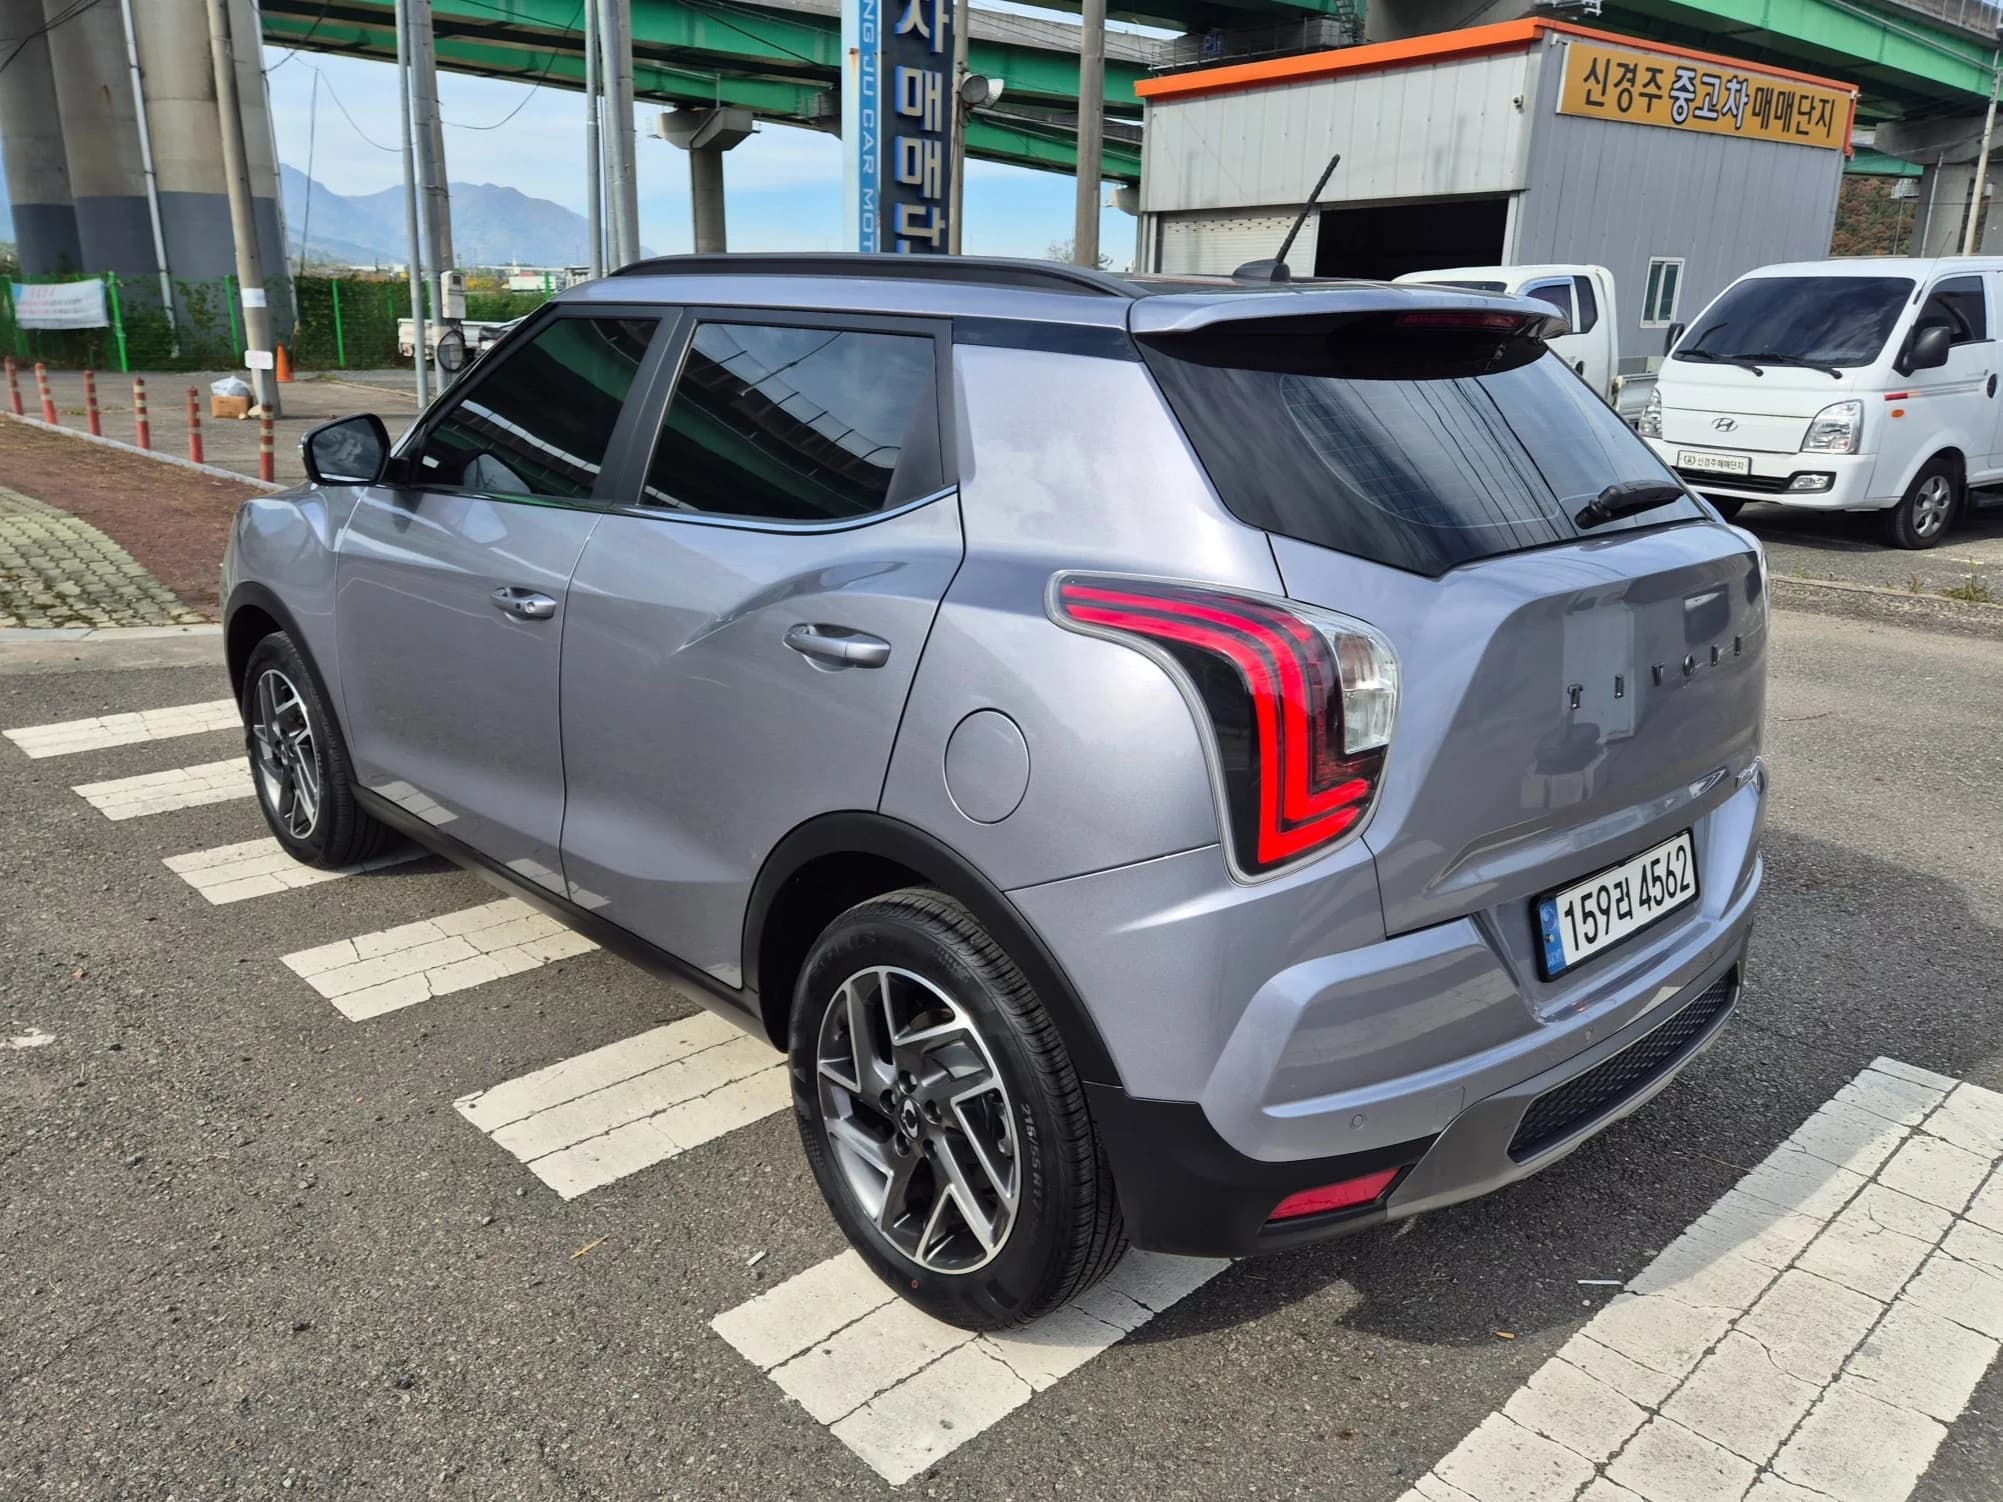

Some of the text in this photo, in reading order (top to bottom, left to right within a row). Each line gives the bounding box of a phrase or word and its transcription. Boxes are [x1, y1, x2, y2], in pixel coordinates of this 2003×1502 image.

[862, 55, 875, 97] JU
[1583, 56, 1836, 138] 신경주 중고차 매매단지
[862, 109, 875, 174] CAR
[1564, 844, 1691, 951] 159러 4562
